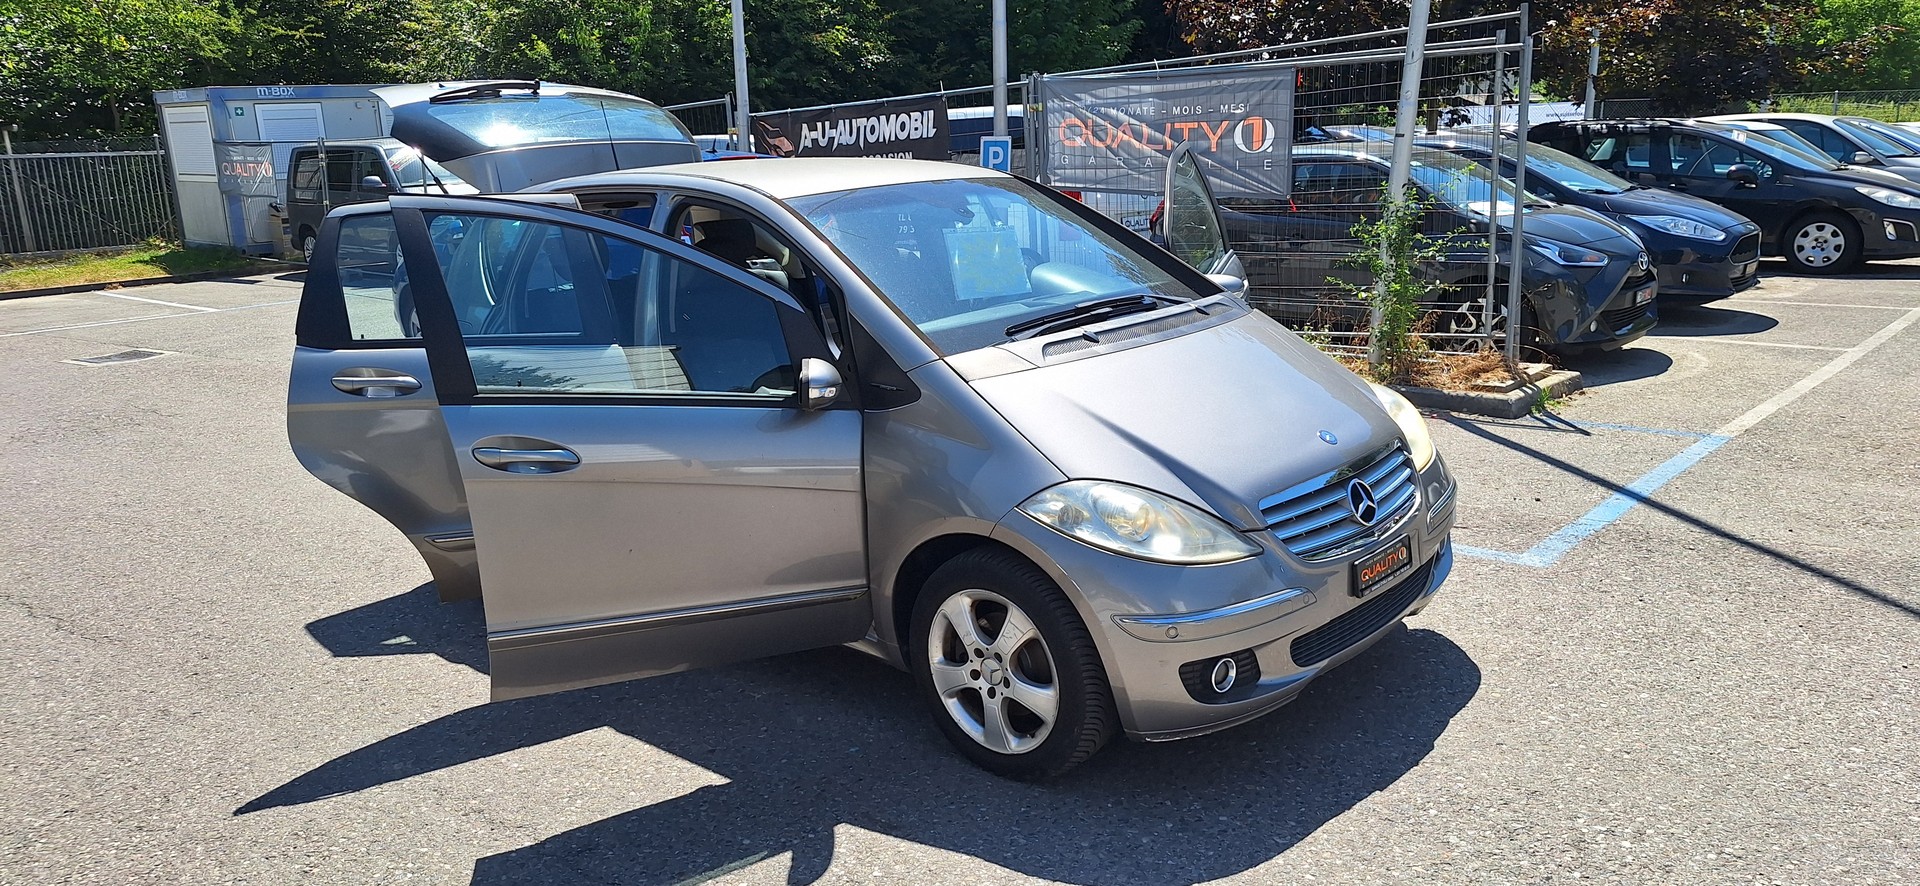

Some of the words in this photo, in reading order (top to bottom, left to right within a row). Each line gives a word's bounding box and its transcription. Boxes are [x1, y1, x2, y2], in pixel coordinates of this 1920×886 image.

[1111, 106, 1156, 116] MONATE
[1172, 105, 1202, 115] MOIS
[1059, 117, 1230, 152] QUALITY
[988, 146, 1004, 168] P
[1361, 552, 1398, 582] QUALITY
